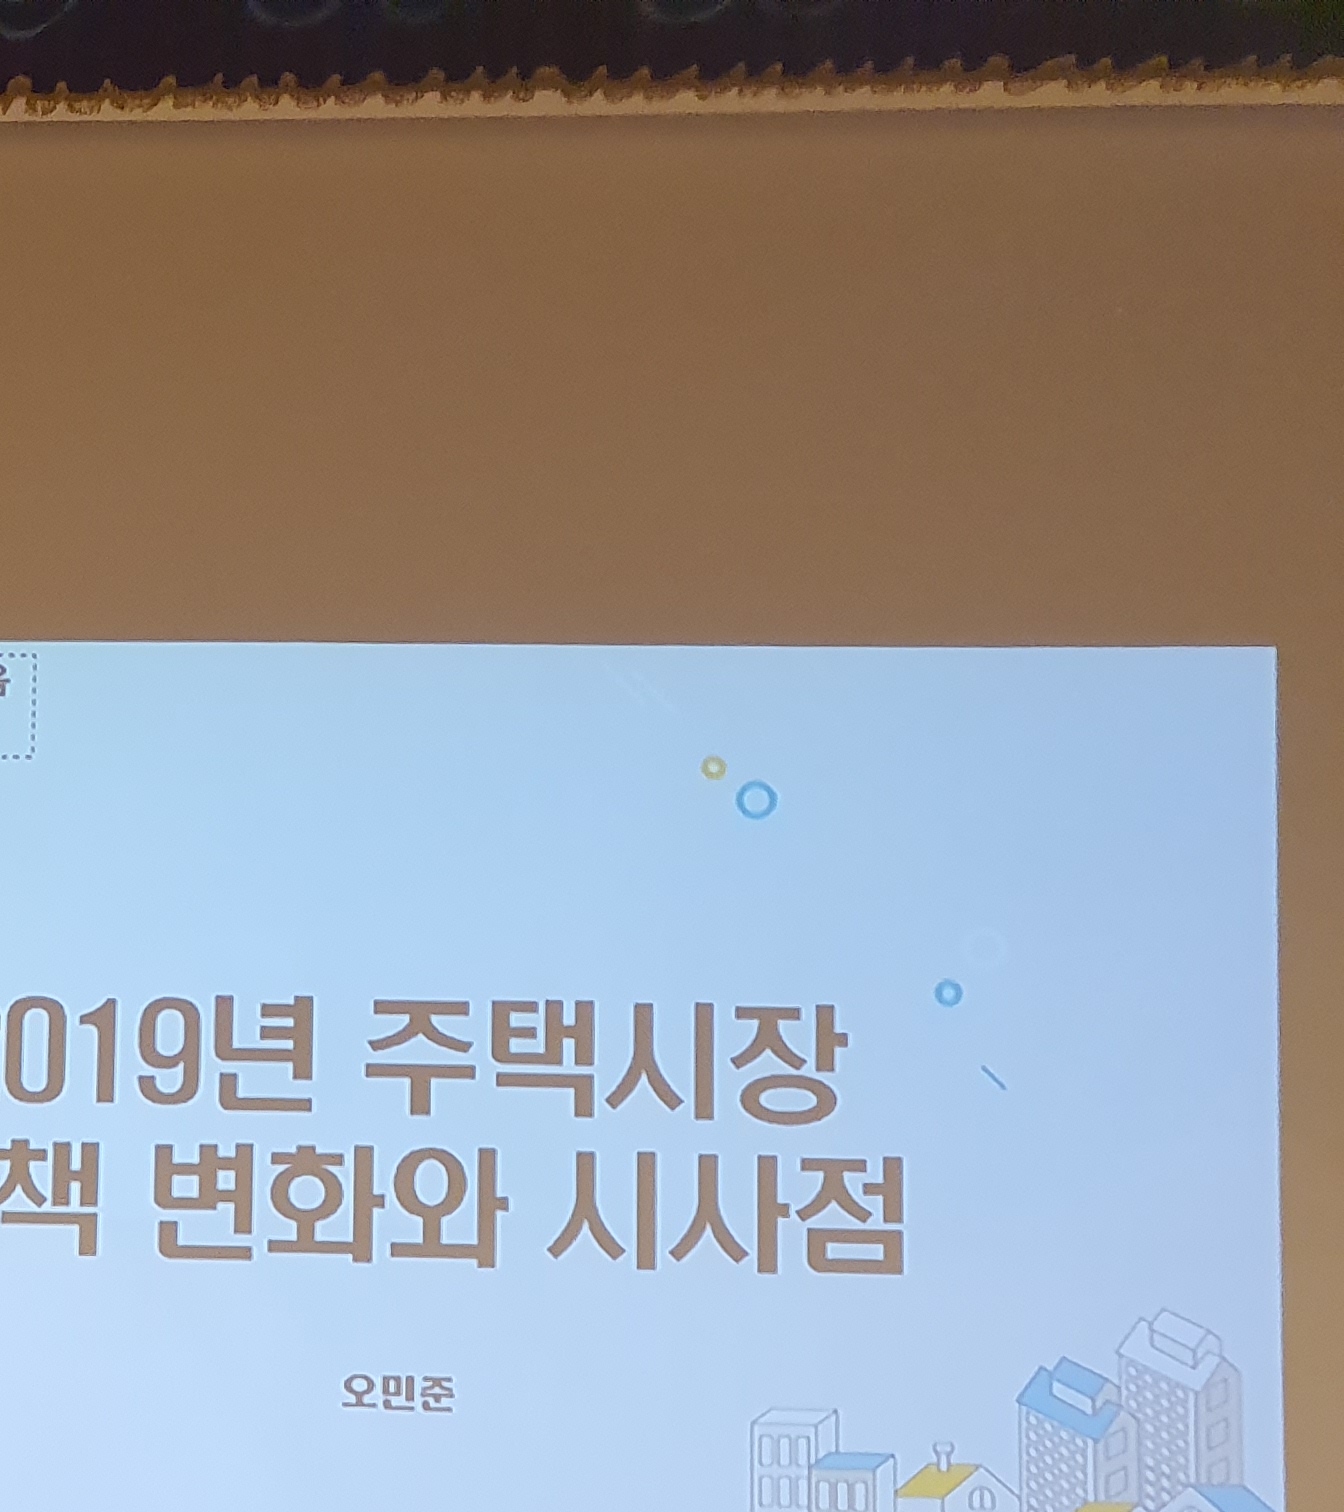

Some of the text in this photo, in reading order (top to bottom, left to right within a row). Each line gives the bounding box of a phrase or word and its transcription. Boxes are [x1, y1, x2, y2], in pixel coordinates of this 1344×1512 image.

[364, 998, 849, 1126] 주택시장
[153, 1141, 510, 1269] 변화와
[547, 1150, 907, 1275] 시사점
[341, 1374, 456, 1414] 오민준
